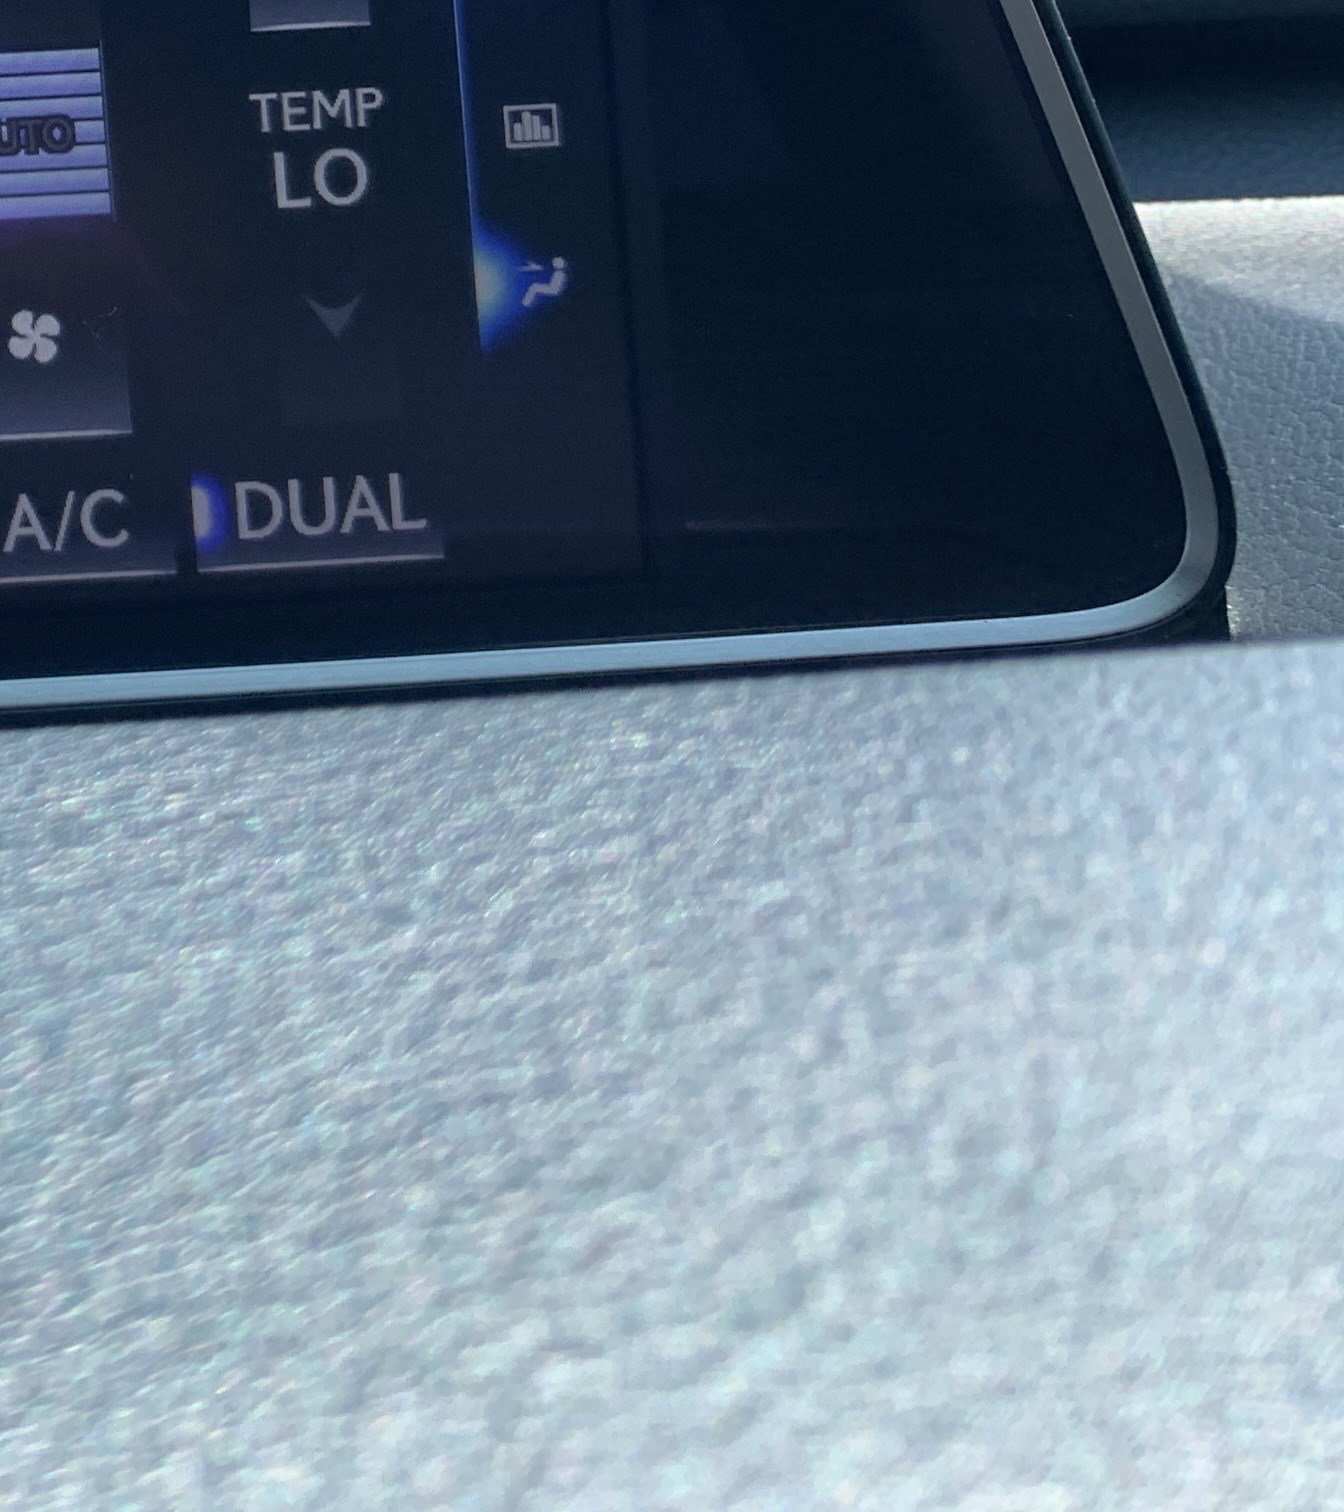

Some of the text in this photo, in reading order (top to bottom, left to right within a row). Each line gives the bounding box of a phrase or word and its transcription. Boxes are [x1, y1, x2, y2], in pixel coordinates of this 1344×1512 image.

[249, 88, 384, 135] TEMP
[273, 147, 370, 210] LO
[2, 489, 130, 553] A/C
[234, 472, 427, 542] DUAL
